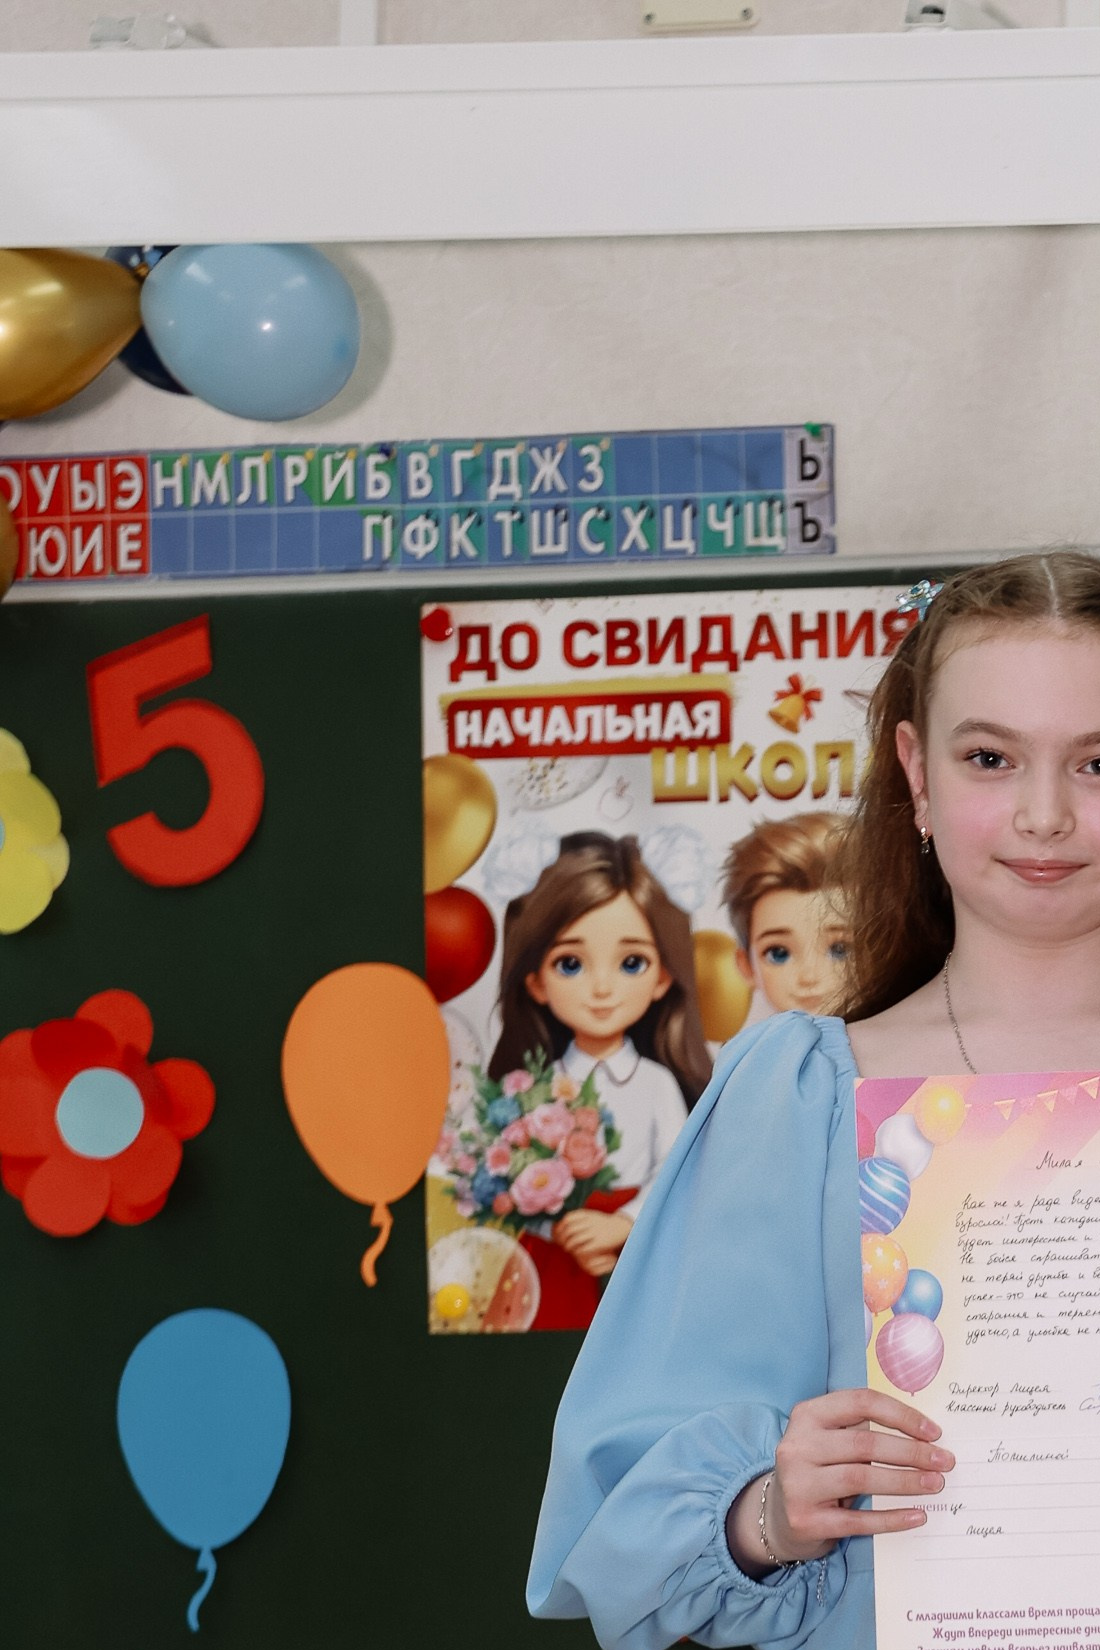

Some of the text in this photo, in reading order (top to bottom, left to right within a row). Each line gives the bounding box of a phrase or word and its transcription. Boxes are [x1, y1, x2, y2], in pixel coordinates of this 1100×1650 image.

[448, 607, 919, 683] ДО СВИДАНИЯ
[453, 700, 722, 749] НАЧАЛЬНАЯ
[86, 614, 264, 887] 5
[650, 741, 874, 804] ШКОЛ
[1036, 1151, 1082, 1169] Милая
[906, 1609, 914, 1621] С
[915, 1612, 974, 1624] младшими
[976, 1609, 1026, 1620] классами
[1028, 1607, 1063, 1620] время
[932, 1627, 966, 1641] Ждут
[968, 1626, 1013, 1639] впереди
[1014, 1626, 1082, 1638] интересные
